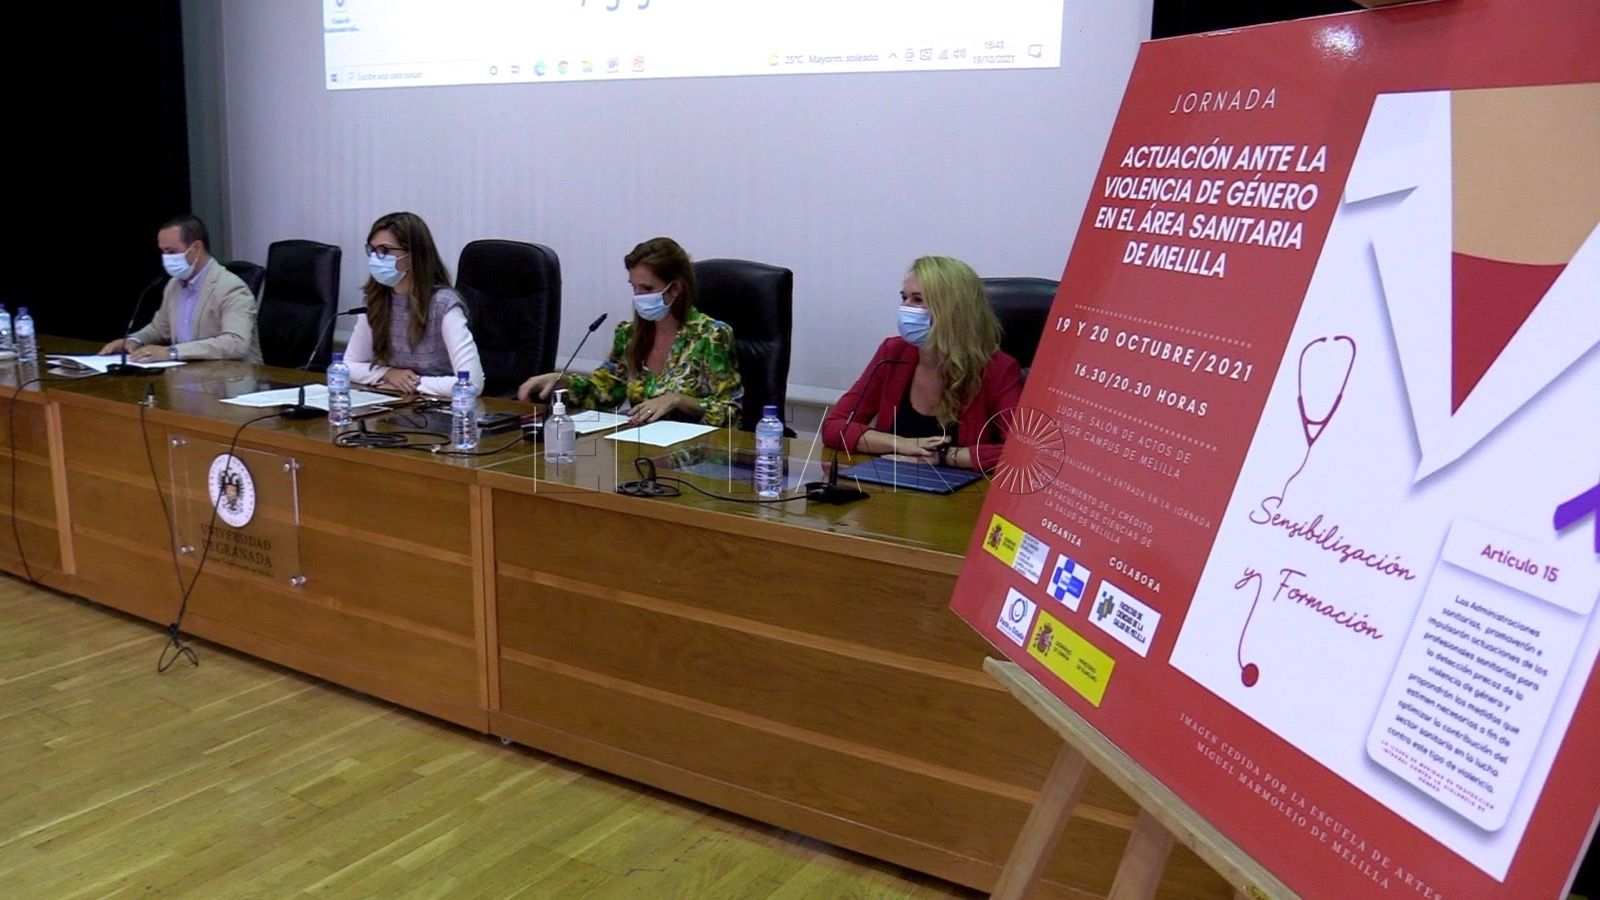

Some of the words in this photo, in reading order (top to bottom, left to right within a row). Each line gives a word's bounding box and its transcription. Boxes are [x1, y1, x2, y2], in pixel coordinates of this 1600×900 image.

[1169, 87, 1277, 115] JORNADA
[1120, 138, 1233, 171] ACTUACIÓN
[1233, 145, 1295, 172] ANTE
[1295, 145, 1327, 173] LA
[1103, 176, 1193, 204] VIOLENCIA
[1195, 180, 1225, 205] DE
[1226, 173, 1319, 212] GÉNERO
[1094, 207, 1117, 229] EN
[1117, 208, 1135, 232] EL
[1137, 203, 1186, 237] ÁREA
[1188, 213, 1304, 250] SANITARIA
[1122, 241, 1148, 266] DE
[1147, 244, 1227, 279] MELILLA
[1055, 317, 1072, 333] 19
[1077, 321, 1087, 337] Y
[1089, 325, 1109, 343] 20
[1115, 331, 1254, 383] OCTUBRE/2021
[1074, 363, 1152, 398] 16.30/20.30
[1155, 388, 1209, 417] HORAS
[1063, 423, 1081, 437] UGR
[1083, 431, 1121, 455] CAMPUS
[1122, 447, 1137, 461] DE
[1139, 454, 1181, 480] MELILLA
[1088, 416, 1118, 435] SALÓN
[1121, 429, 1136, 442] DE
[1136, 436, 1173, 457] ACTOS
[1176, 449, 1192, 465] DE
[1044, 498, 1053, 507] LA
[1055, 503, 1077, 520] SALUD
[1078, 516, 1089, 528] DE
[1090, 522, 1120, 545] MELILLA
[1054, 490, 1089, 514] FACULTAD
[1089, 510, 1101, 521] DE
[1102, 516, 1139, 541] CIENCIAS
[1140, 536, 1153, 549] DE
[1098, 501, 1110, 512] DE
[1102, 474, 1112, 482] LA
[1113, 478, 1146, 498] ENTRADA
[1147, 493, 1159, 505] EN
[1160, 501, 1171, 510] LA
[1172, 507, 1211, 530] JORNADA
[215, 540, 273, 568] GRANADA
[1041, 517, 1083, 548] ORGANIZA
[1249, 495, 1417, 581] Sensibilización
[1108, 556, 1162, 594] COLABORA
[1480, 543, 1539, 576] Artículo
[1542, 565, 1560, 583] 15
[1272, 568, 1384, 641] Formación
[1455, 595, 1470, 608] Las
[1470, 601, 1541, 638] Administraciones
[1423, 632, 1476, 661] profesionales
[1517, 676, 1540, 691] para
[1471, 636, 1521, 665] actuaciones
[1521, 658, 1533, 670] de
[1534, 664, 1548, 677] los
[1484, 626, 1536, 653] promoverán
[1536, 649, 1543, 657] e
[1426, 647, 1435, 657] la
[1435, 652, 1474, 676] detección
[1473, 672, 1502, 691] precoz
[1502, 684, 1514, 696] de
[1515, 690, 1524, 700] la
[1428, 665, 1462, 687] violencia
[1462, 682, 1474, 693] de
[1474, 689, 1504, 708] género
[1504, 705, 1511, 713] y
[1406, 687, 1436, 707] estimen
[1486, 728, 1498, 741] fin
[1498, 736, 1511, 747] de
[1408, 672, 1454, 700] propondrán
[1467, 703, 1502, 725] medidas
[1502, 721, 1521, 735] que
[1387, 726, 1412, 745] contra
[1412, 741, 1429, 755] este
[1429, 750, 1445, 765] tipo
[1445, 760, 1457, 771] de
[1395, 714, 1418, 730] sector
[1419, 727, 1454, 751] sanitario
[1454, 747, 1465, 758] en
[1465, 752, 1475, 763] la
[1474, 758, 1499, 778] lucha
[1398, 700, 1433, 722] optimizar
[1433, 717, 1442, 728] la
[1442, 724, 1493, 756] contribución
[1493, 752, 1509, 765] del
[1179, 712, 1218, 748] IMAGEN
[1220, 740, 1261, 776] CEDIDA
[1263, 772, 1288, 796] POR
[1290, 792, 1307, 809] LA
[1309, 805, 1367, 853] ESCUELA
[1371, 849, 1392, 869] DE
[1393, 866, 1443, 900] ARTES
[1196, 741, 1236, 777] MIGUEL
[1237, 774, 1307, 828] MARMOLEJO
[1309, 824, 1328, 844] DE
[1331, 841, 1391, 889] MELILLA
